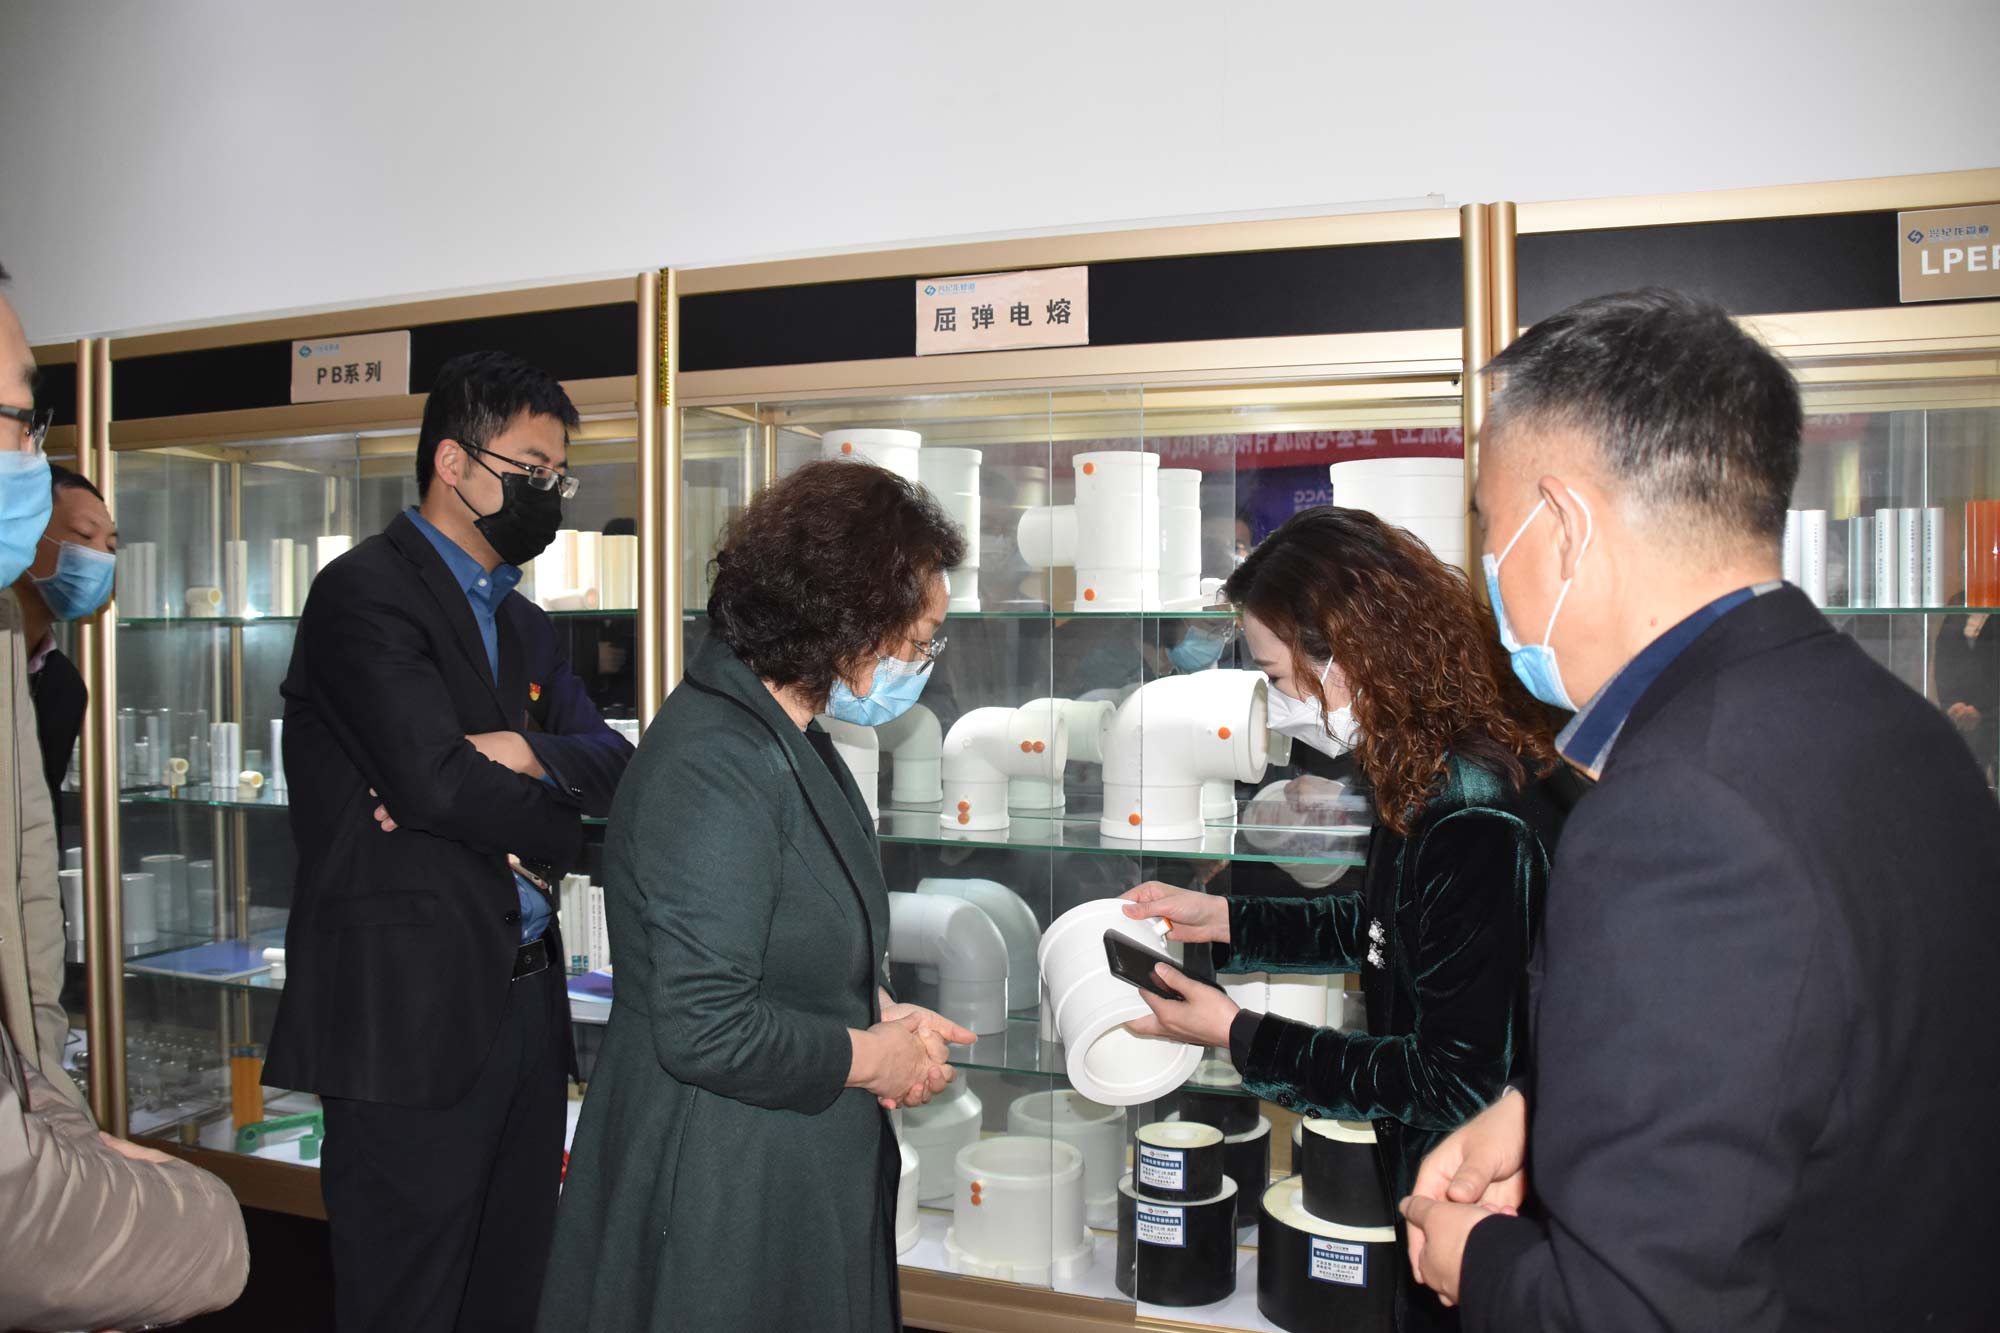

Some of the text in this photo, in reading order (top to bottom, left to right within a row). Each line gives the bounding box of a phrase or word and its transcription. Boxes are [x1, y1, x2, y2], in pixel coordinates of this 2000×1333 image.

[933, 298, 1072, 332] 屈弹电熔
[316, 360, 382, 385] PB系列
